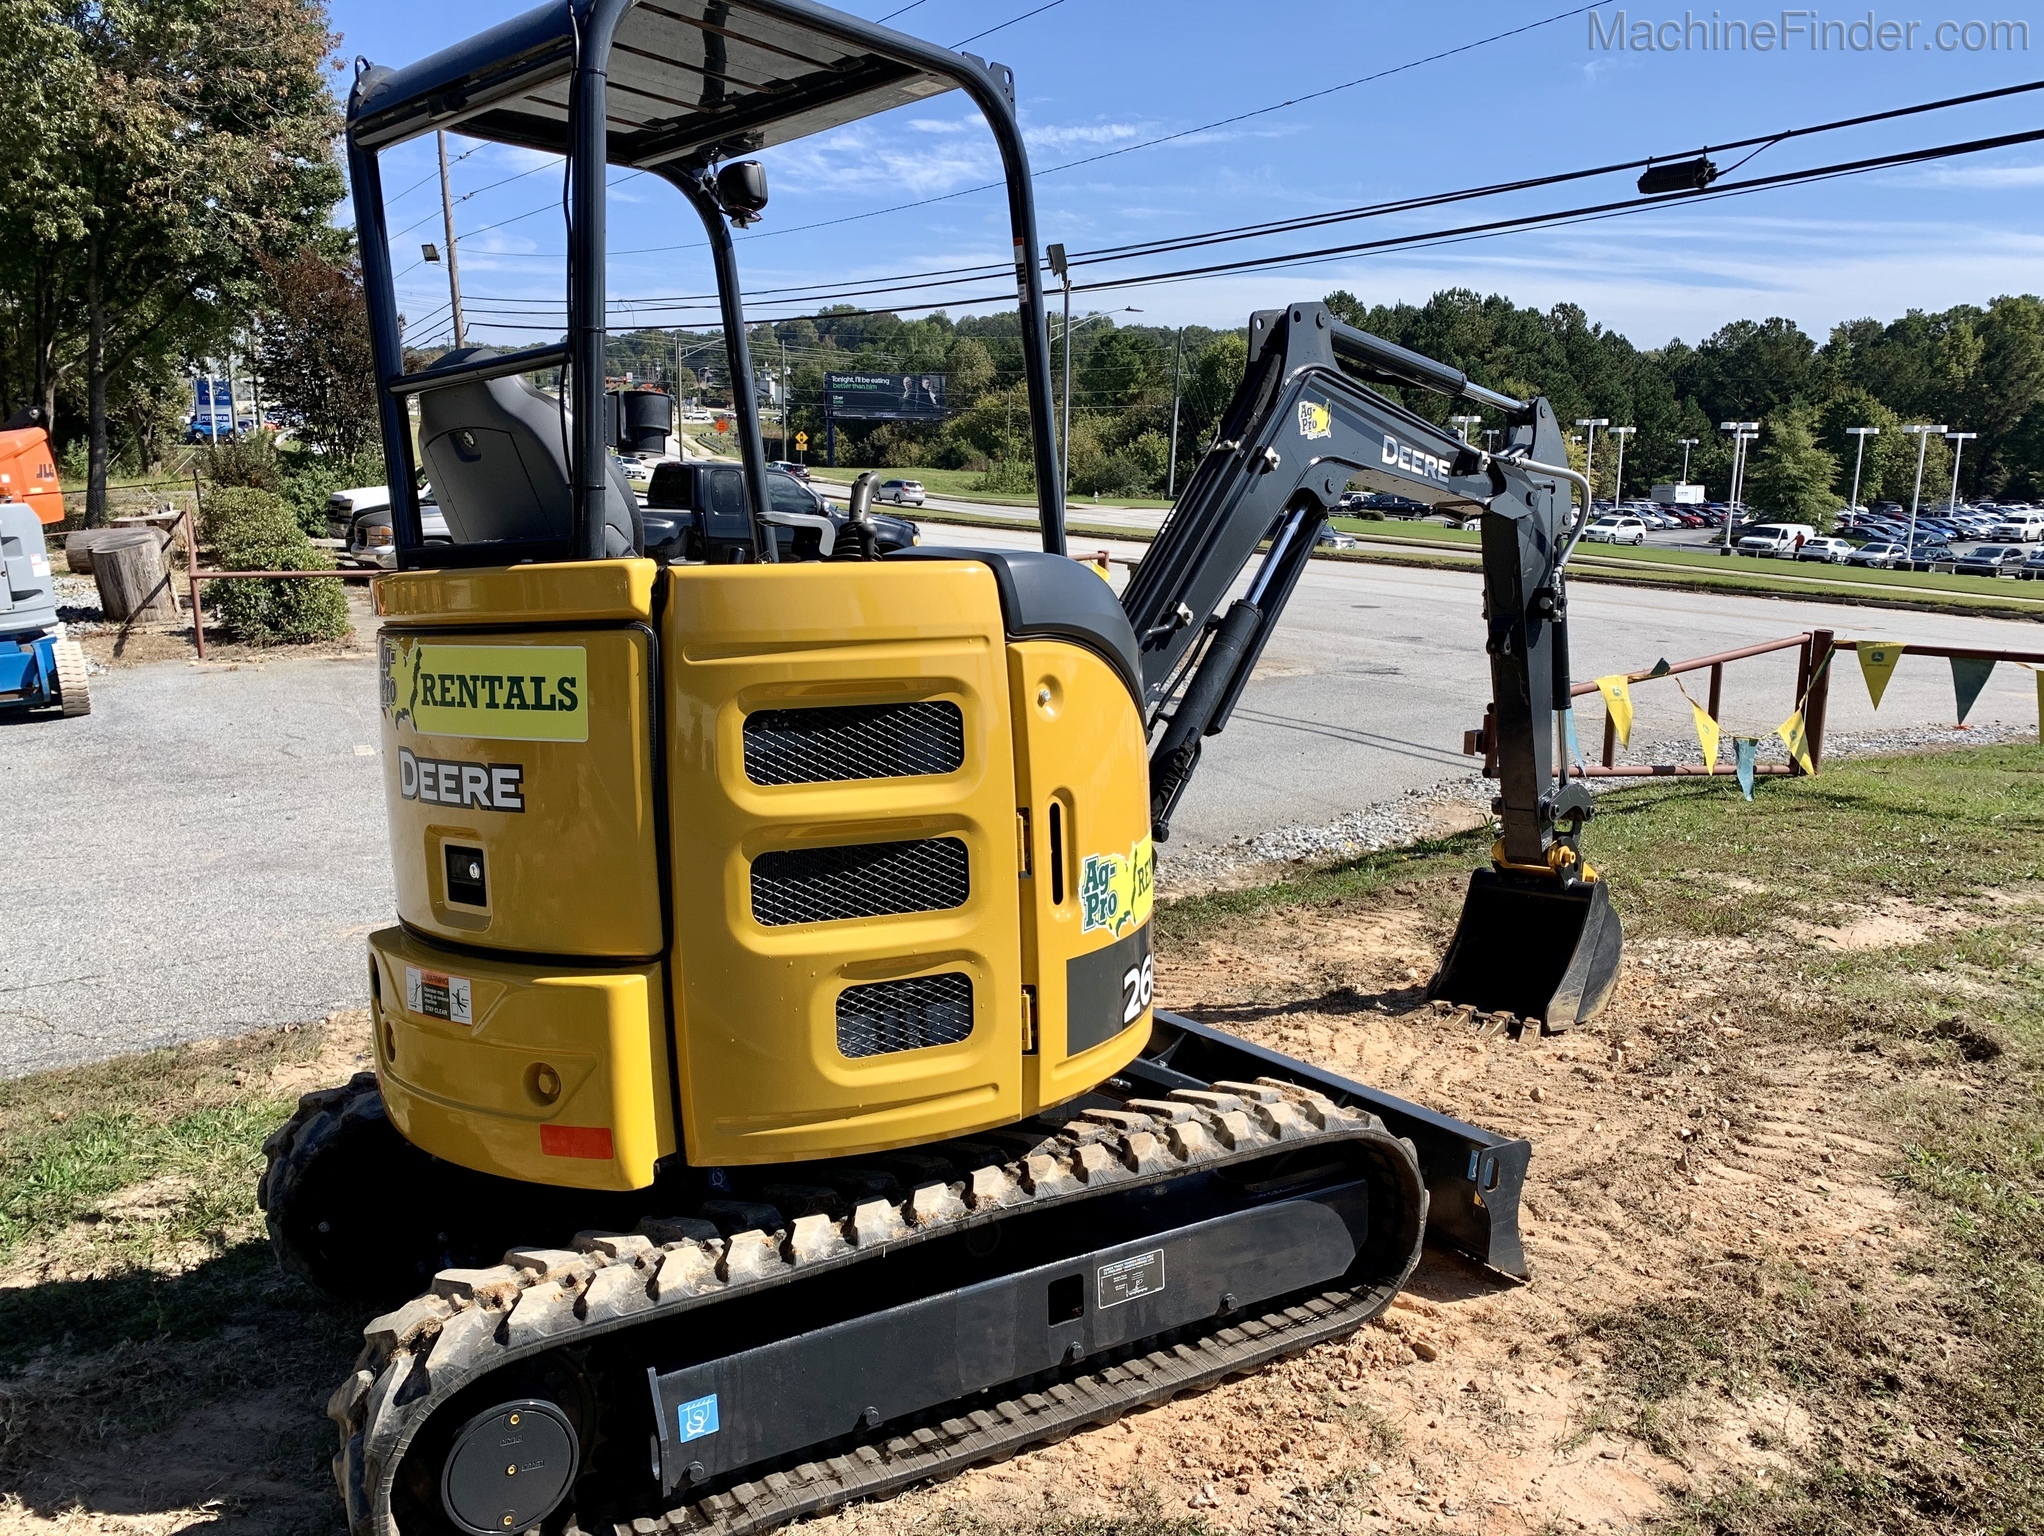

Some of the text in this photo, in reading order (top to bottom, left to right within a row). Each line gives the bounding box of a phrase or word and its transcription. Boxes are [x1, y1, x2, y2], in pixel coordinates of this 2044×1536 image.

[871, 378, 890, 386] eating
[1302, 418, 1317, 431] Pro
[1381, 434, 1451, 484] DEERE
[420, 673, 579, 712] RENTALS
[399, 748, 523, 810] DEERE
[1085, 891, 1118, 931] Pro
[426, 974, 449, 985] WARNING
[434, 1007, 448, 1016] CLEAR
